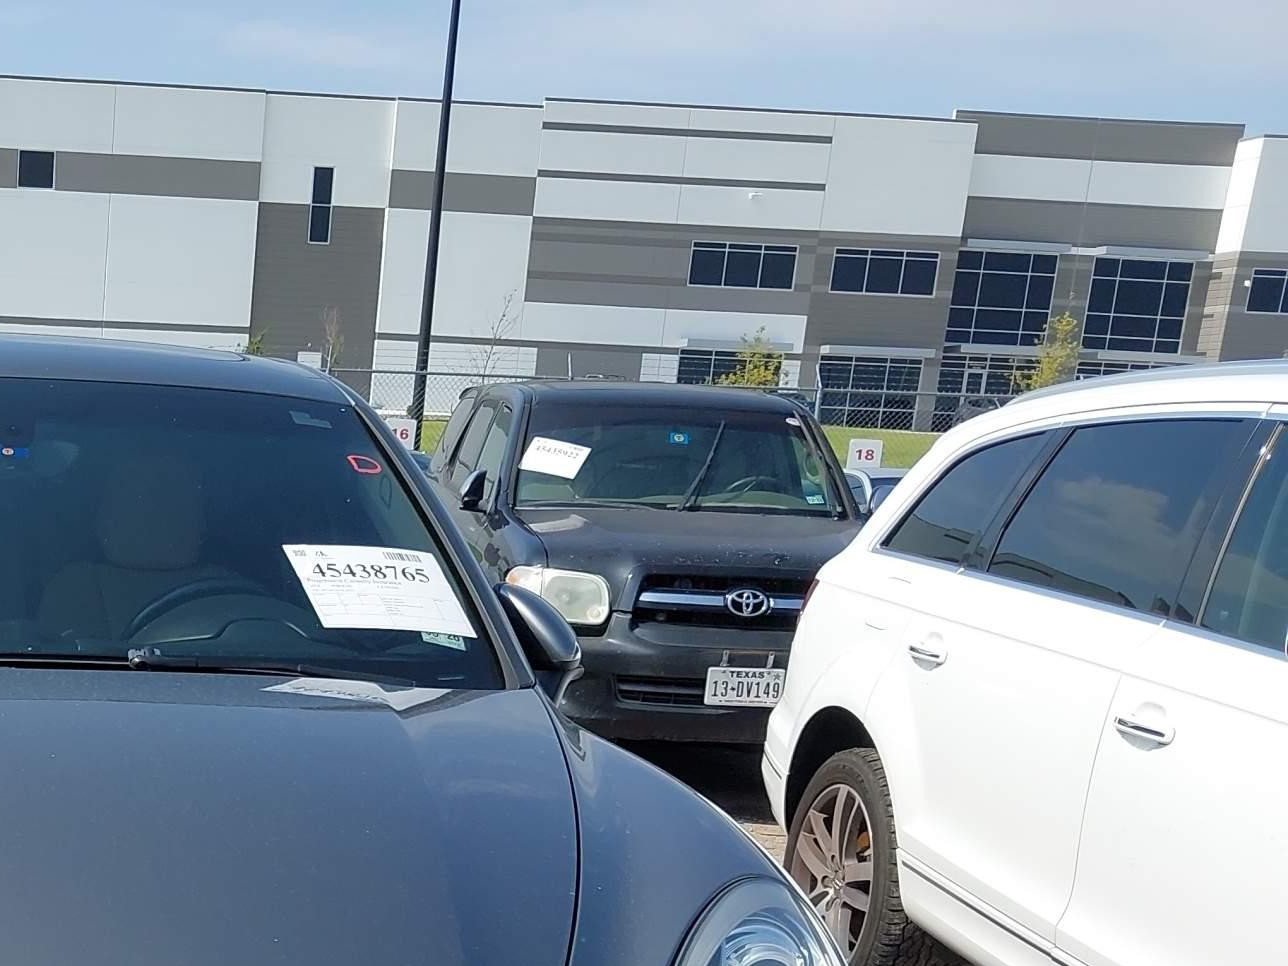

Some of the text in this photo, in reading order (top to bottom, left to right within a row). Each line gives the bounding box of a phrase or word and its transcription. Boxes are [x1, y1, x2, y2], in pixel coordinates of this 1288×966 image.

[392, 428, 409, 440] 16
[855, 449, 875, 461] 18
[312, 563, 430, 583] 45438765
[729, 670, 766, 679] TEXAS
